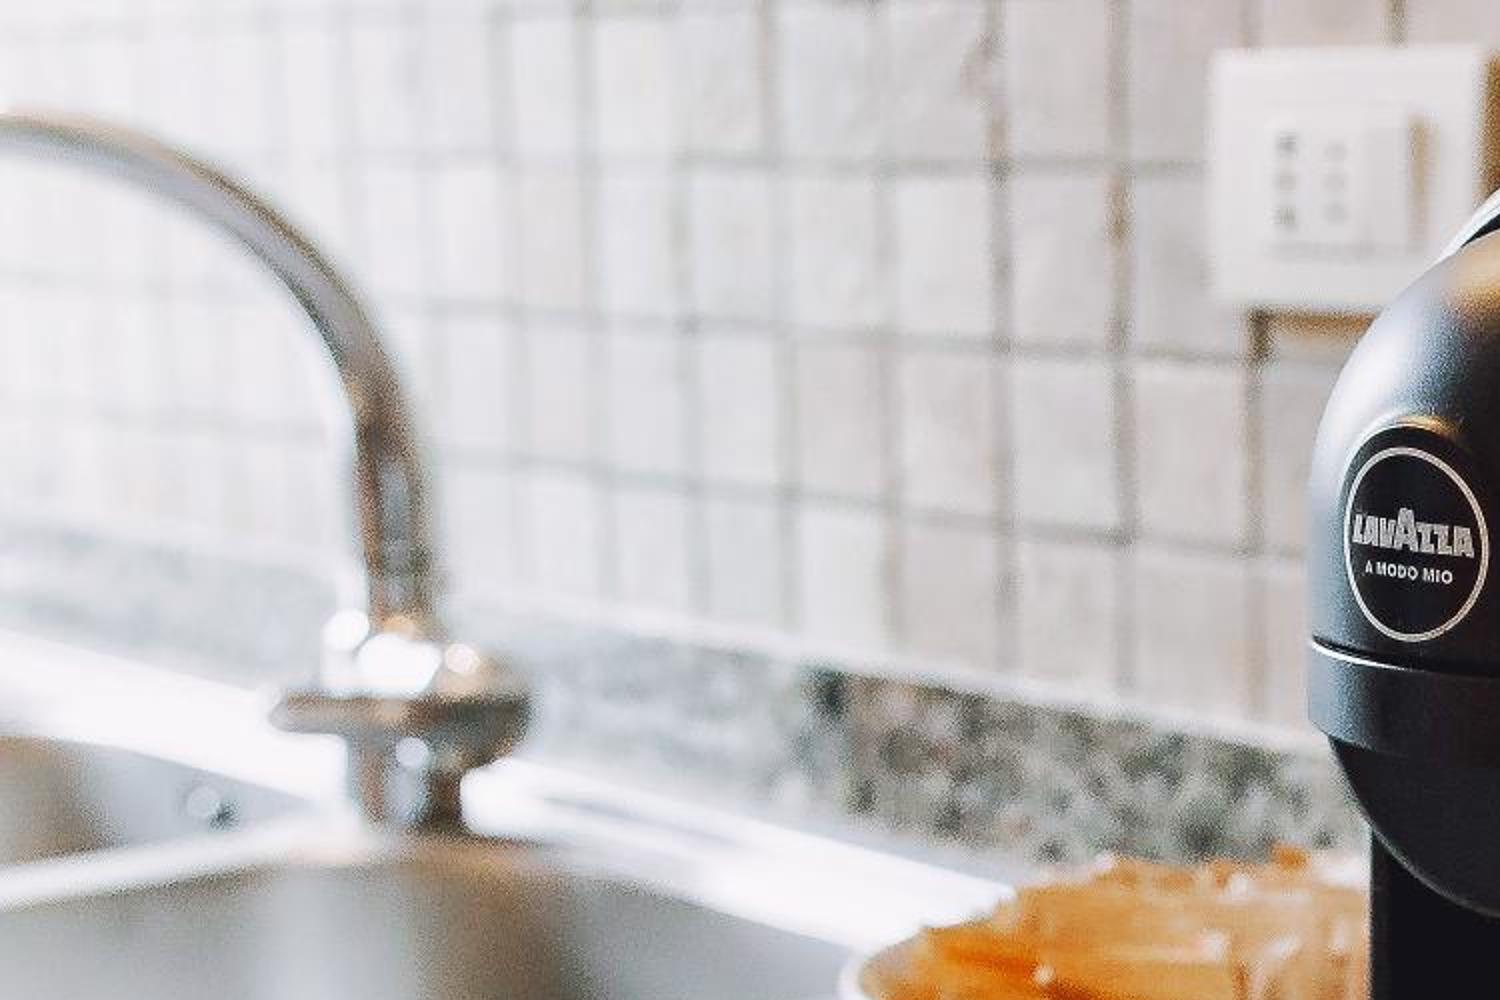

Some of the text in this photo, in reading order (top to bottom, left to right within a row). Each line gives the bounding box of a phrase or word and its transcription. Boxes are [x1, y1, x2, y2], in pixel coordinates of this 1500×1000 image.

[1352, 507, 1475, 558] LAVAZZA
[1365, 560, 1453, 585] A MODO MIO
